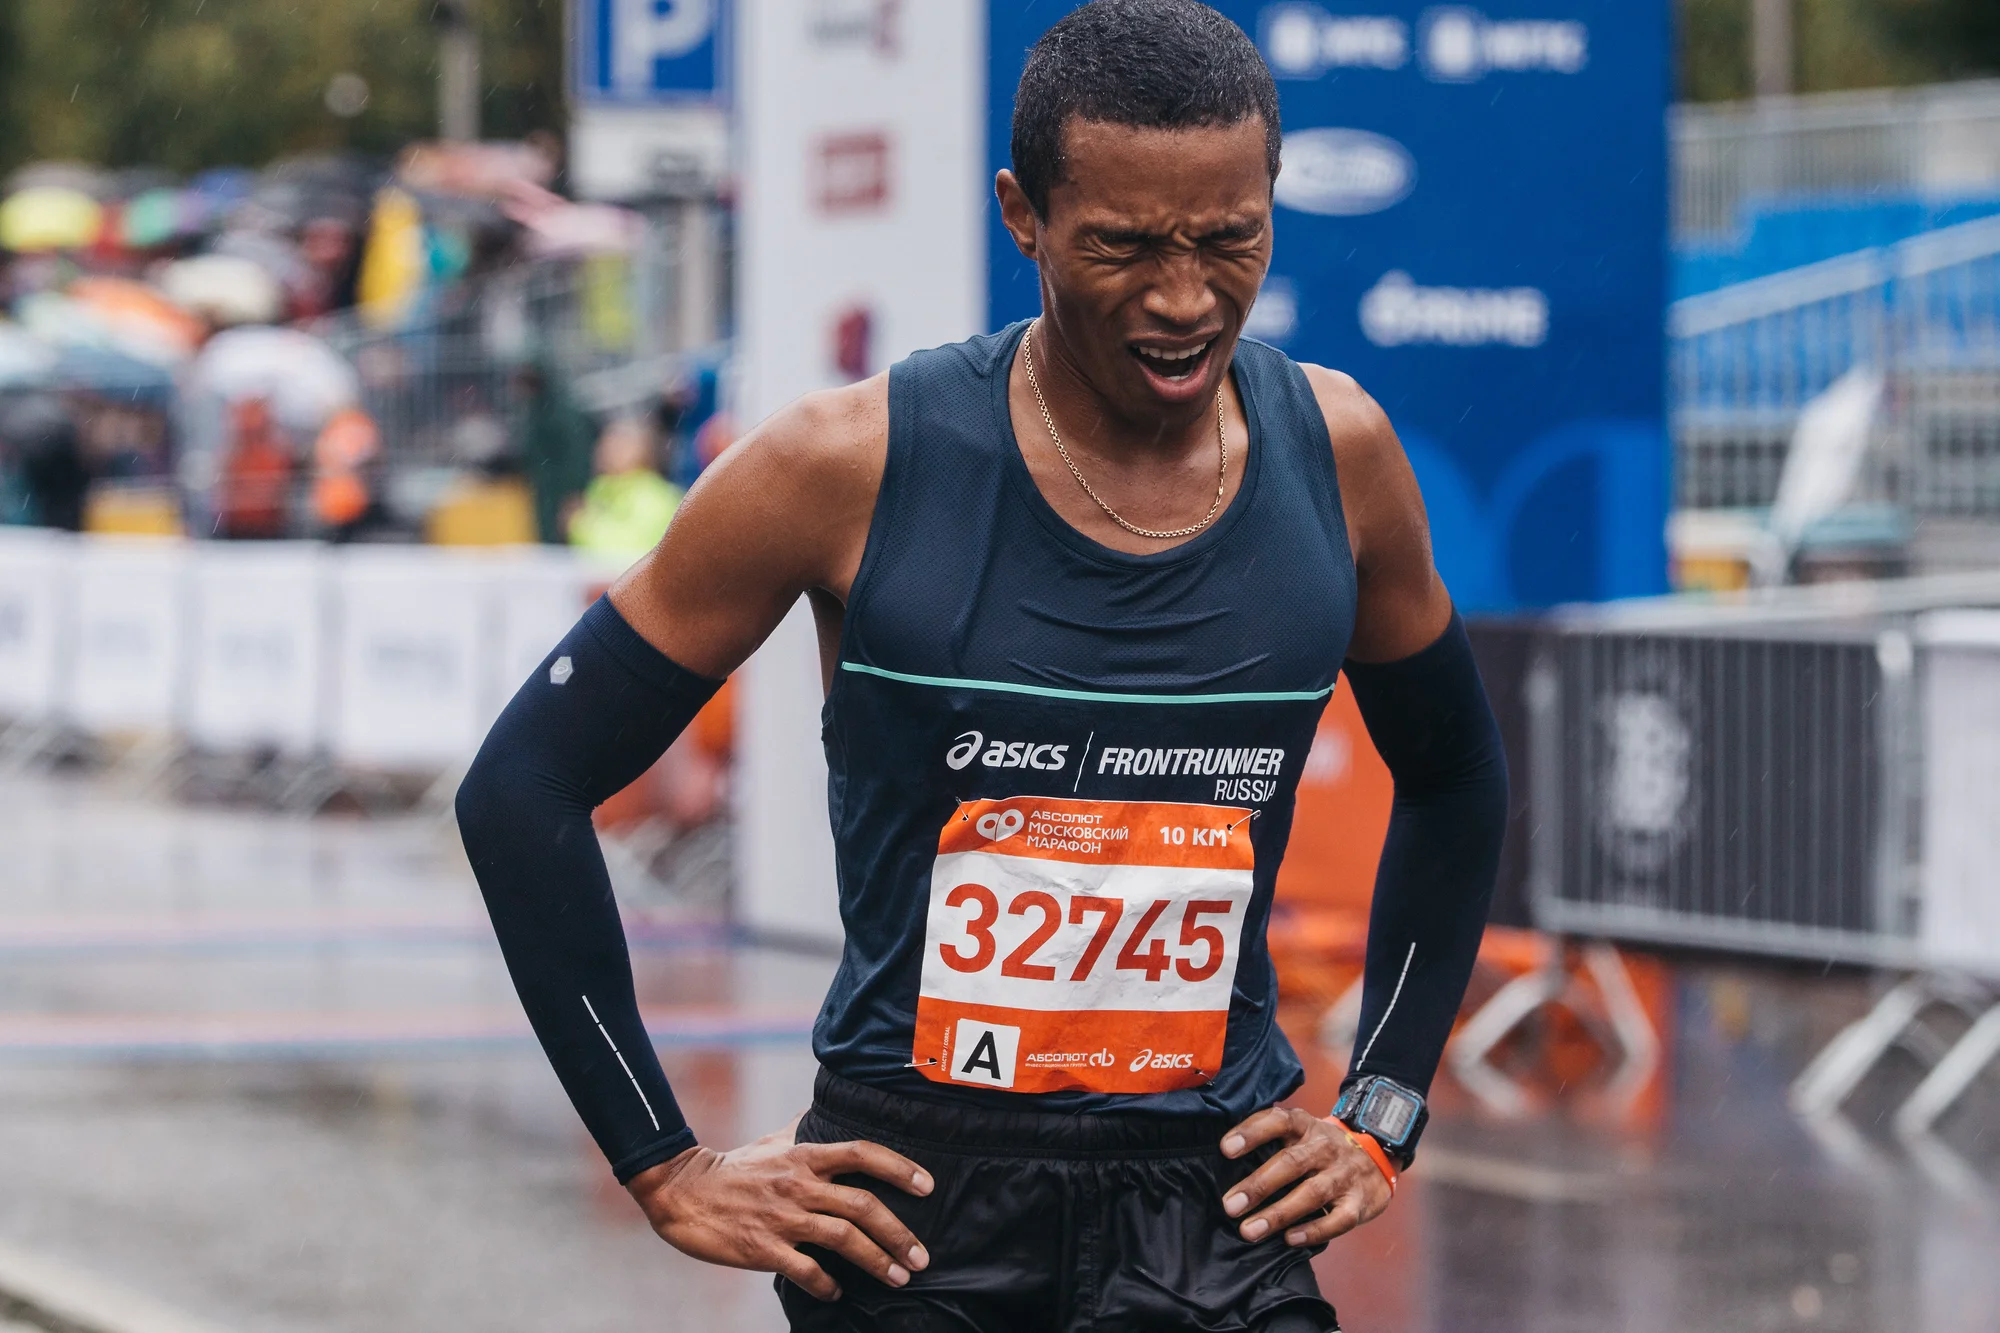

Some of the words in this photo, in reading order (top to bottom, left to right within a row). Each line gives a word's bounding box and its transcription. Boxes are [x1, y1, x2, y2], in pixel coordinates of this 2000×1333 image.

[1098, 747, 1285, 776] FRONTRUNNER
[1214, 779, 1277, 802] RUSSIA
[1031, 810, 1103, 825] АБСОЛЮТ
[1028, 821, 1129, 841] МОСКОВСКИЙ
[1159, 826, 1185, 845] 10
[1026, 835, 1102, 854] МАРАФОН
[938, 883, 1234, 982] 32745
[1026, 1053, 1088, 1062] АБСОЛЮТ
